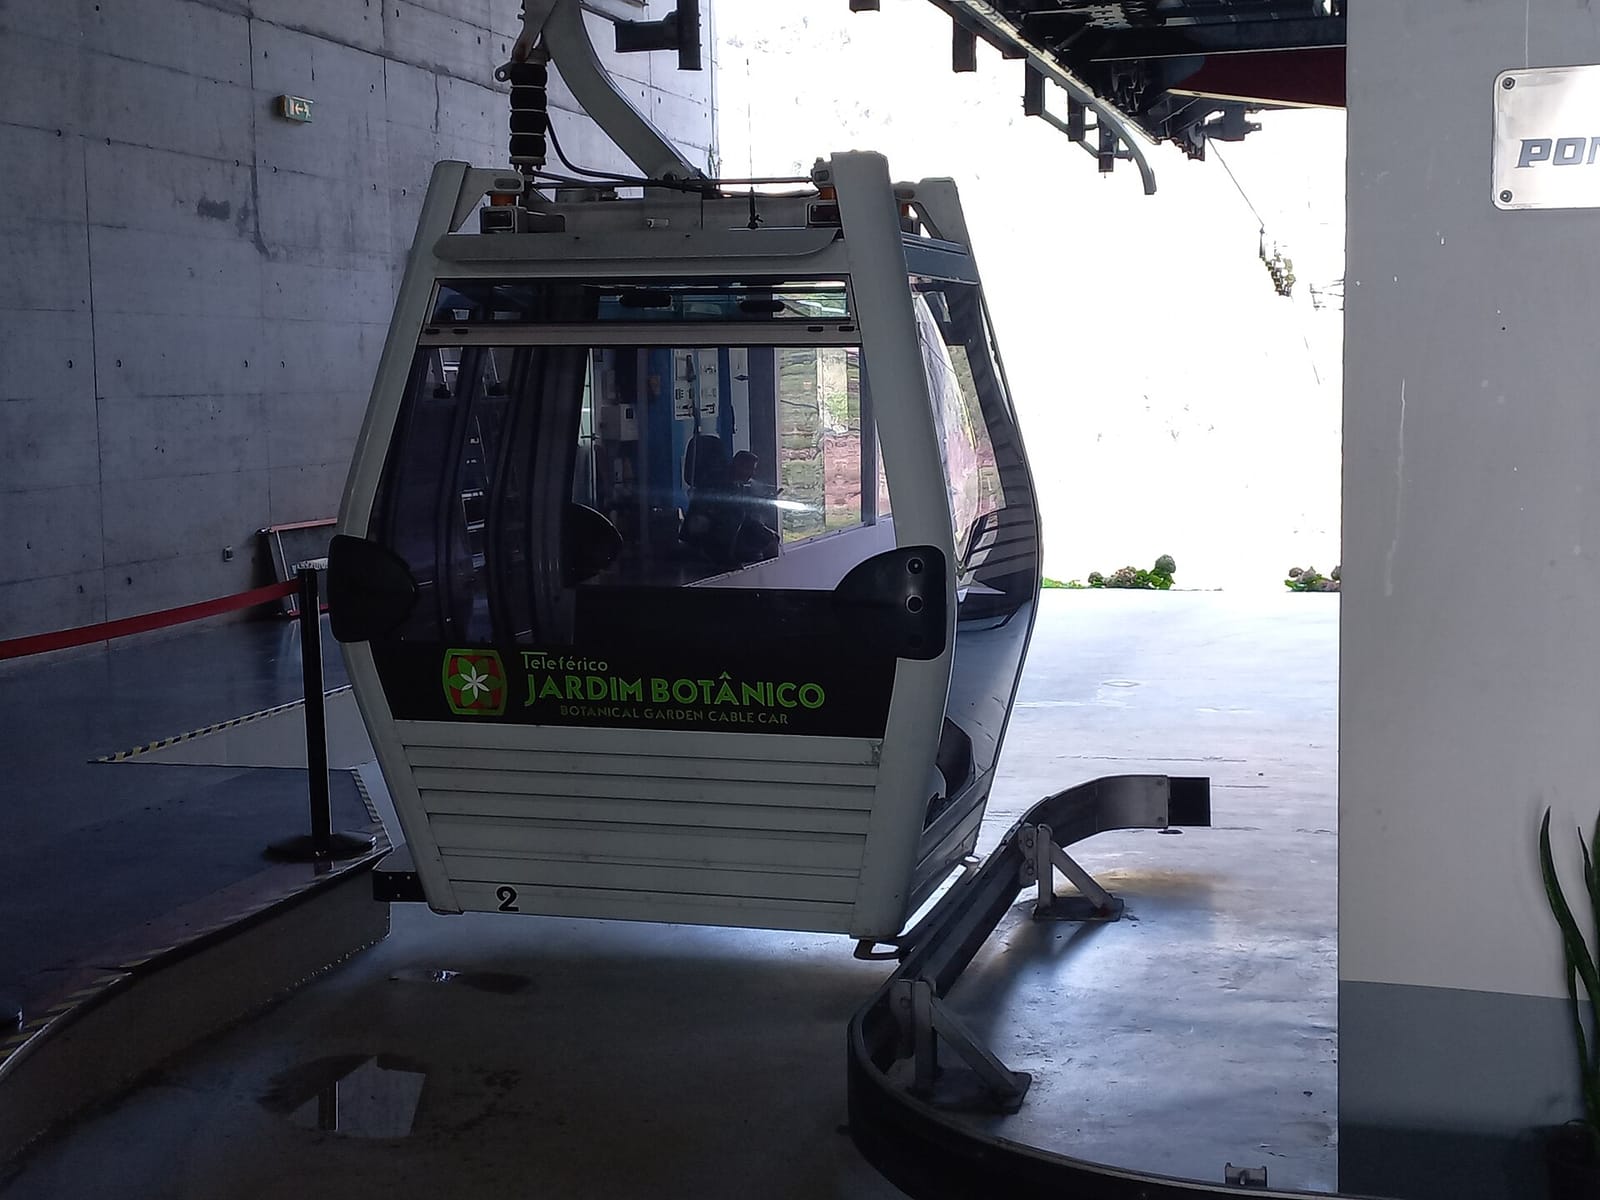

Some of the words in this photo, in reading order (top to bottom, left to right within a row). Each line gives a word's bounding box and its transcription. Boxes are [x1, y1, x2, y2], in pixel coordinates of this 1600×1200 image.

[520, 650, 609, 672] Teleférico
[523, 673, 643, 707] JARDIM
[650, 671, 826, 709] BOTÂNICO
[560, 705, 640, 719] BOTANICAL
[643, 707, 704, 721] GARDEN
[707, 710, 754, 724] CABLE
[757, 712, 789, 725] CAR
[496, 886, 519, 912] 2
